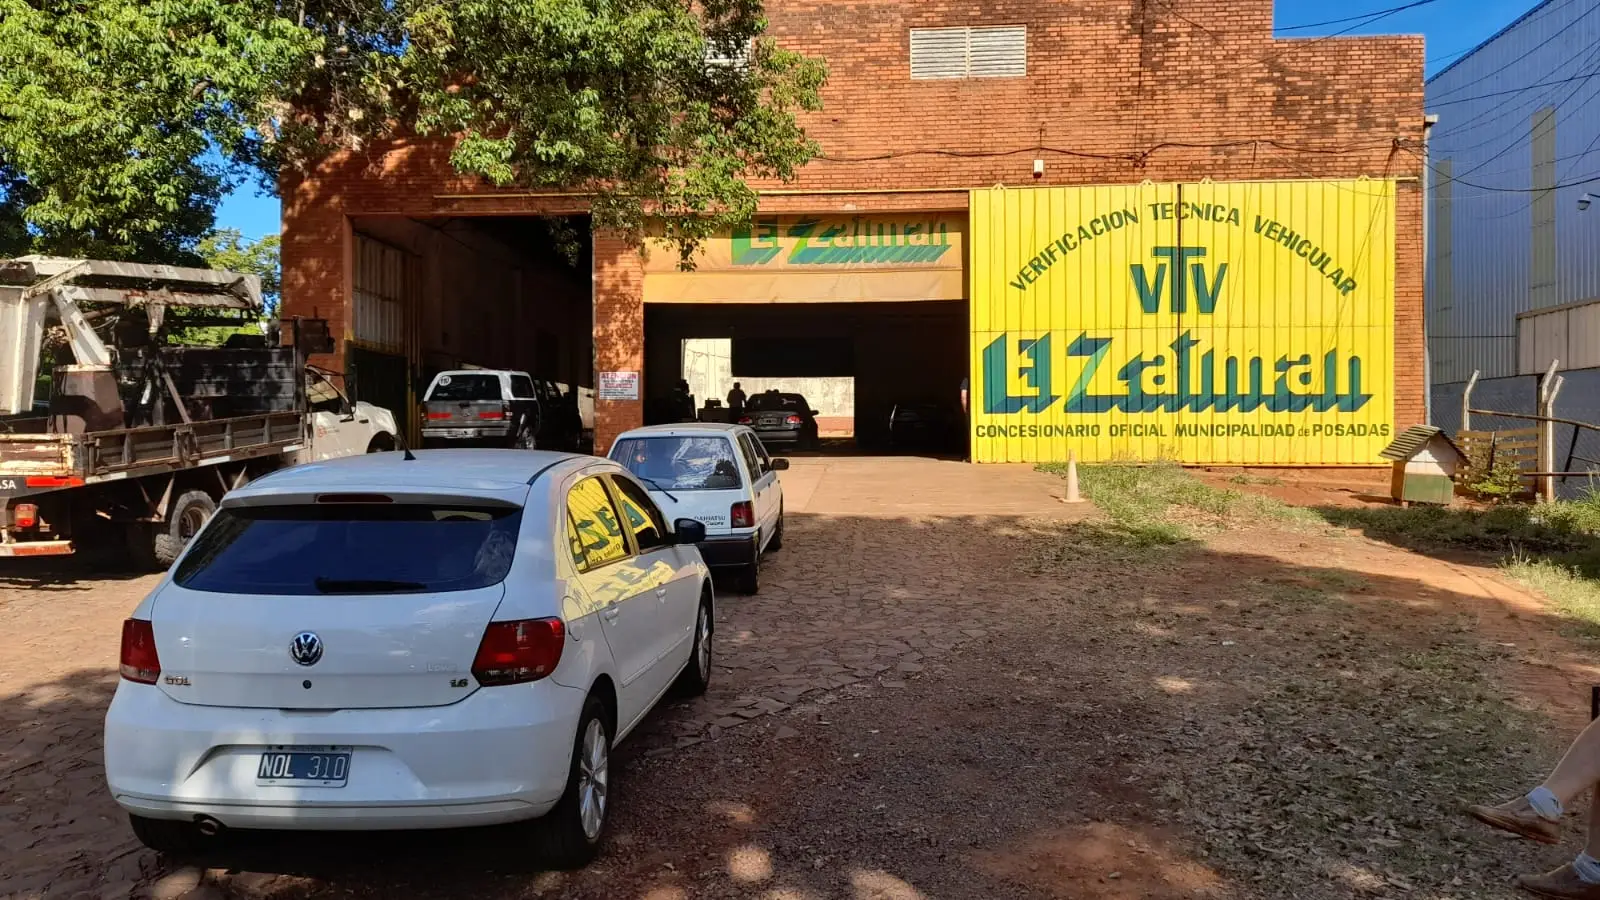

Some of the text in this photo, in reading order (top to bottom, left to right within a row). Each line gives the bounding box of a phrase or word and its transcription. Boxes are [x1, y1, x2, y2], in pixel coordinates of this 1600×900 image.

[1009, 201, 1358, 297] VERIFICACION TECNICA VEHICULAR
[1129, 246, 1229, 315] VTV
[982, 330, 1062, 414] El
[975, 423, 1390, 438] CONCESIONARIO OFICIAL MUNICIPALIDAD de POSADAS
[259, 754, 346, 778] NOL 310
